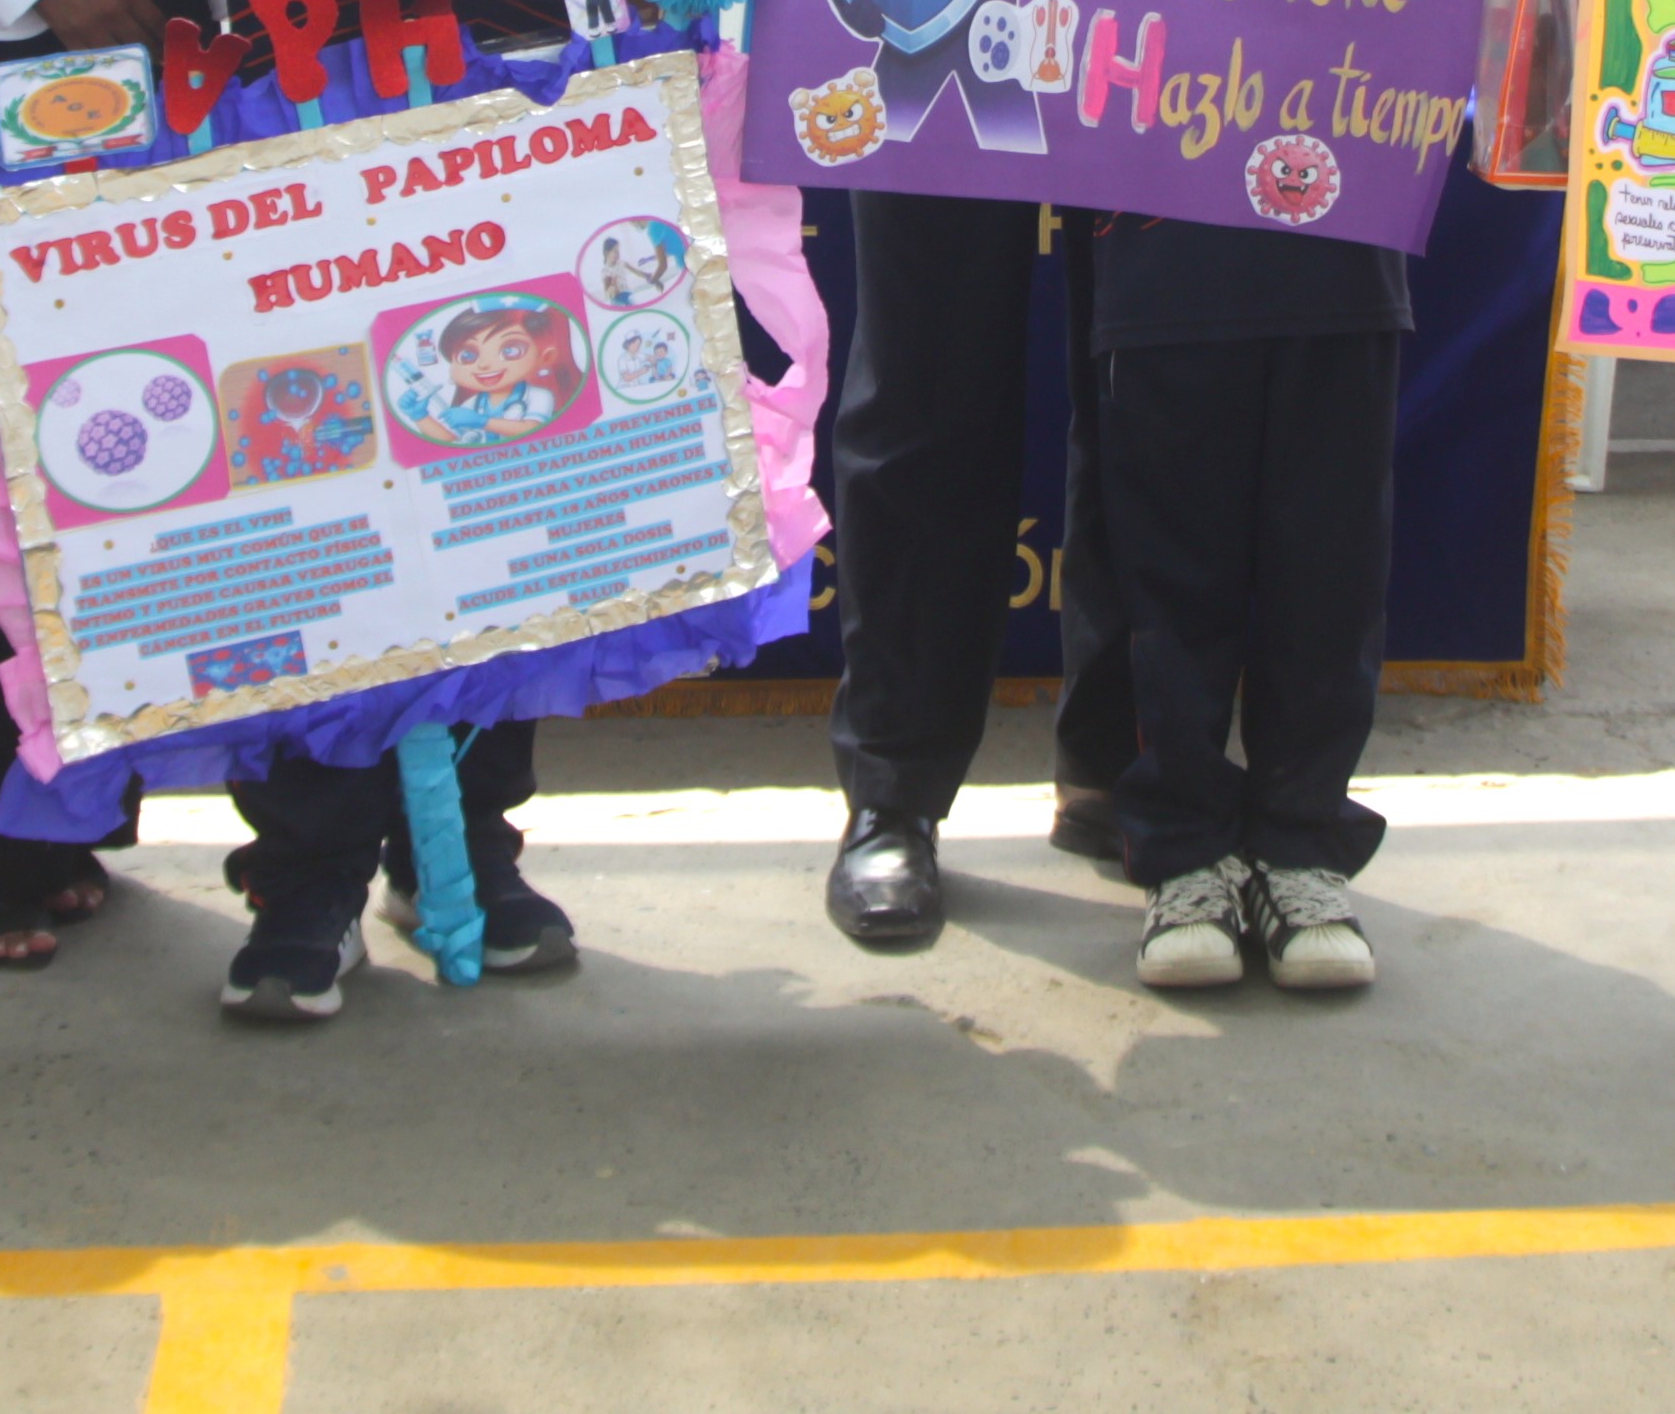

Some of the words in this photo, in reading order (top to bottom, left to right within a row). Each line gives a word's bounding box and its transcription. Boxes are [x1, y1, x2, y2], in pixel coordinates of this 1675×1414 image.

[1078, 8, 1263, 161] Hazlo
[1278, 77, 1315, 135] a
[1330, 41, 1467, 175] tiempo
[10, 213, 197, 284] VIRUS
[207, 182, 323, 243] DEL
[363, 106, 656, 204] PAPILOMA
[248, 220, 508, 314] HUMANO
[420, 465, 444, 481] LA
[446, 446, 522, 473] VACUNA
[527, 431, 589, 455] AYUDA
[592, 427, 606, 440] A
[609, 402, 694, 434] PREVENIR
[697, 397, 718, 411] EL
[442, 473, 497, 494] VIRUS
[501, 466, 534, 482] DEL
[538, 444, 625, 473] PAPILOMA
[629, 421, 703, 449] HUMANO
[447, 523, 495, 544] AÑOS
[498, 508, 557, 532] HASTA
[584, 490, 630, 510] AÑOS
[633, 469, 714, 496] VARONES
[449, 492, 519, 519] EDADES
[523, 481, 571, 501] PARA
[574, 450, 680, 487] VACUNARSE
[683, 445, 706, 461] DE
[547, 512, 626, 541] MUJERES
